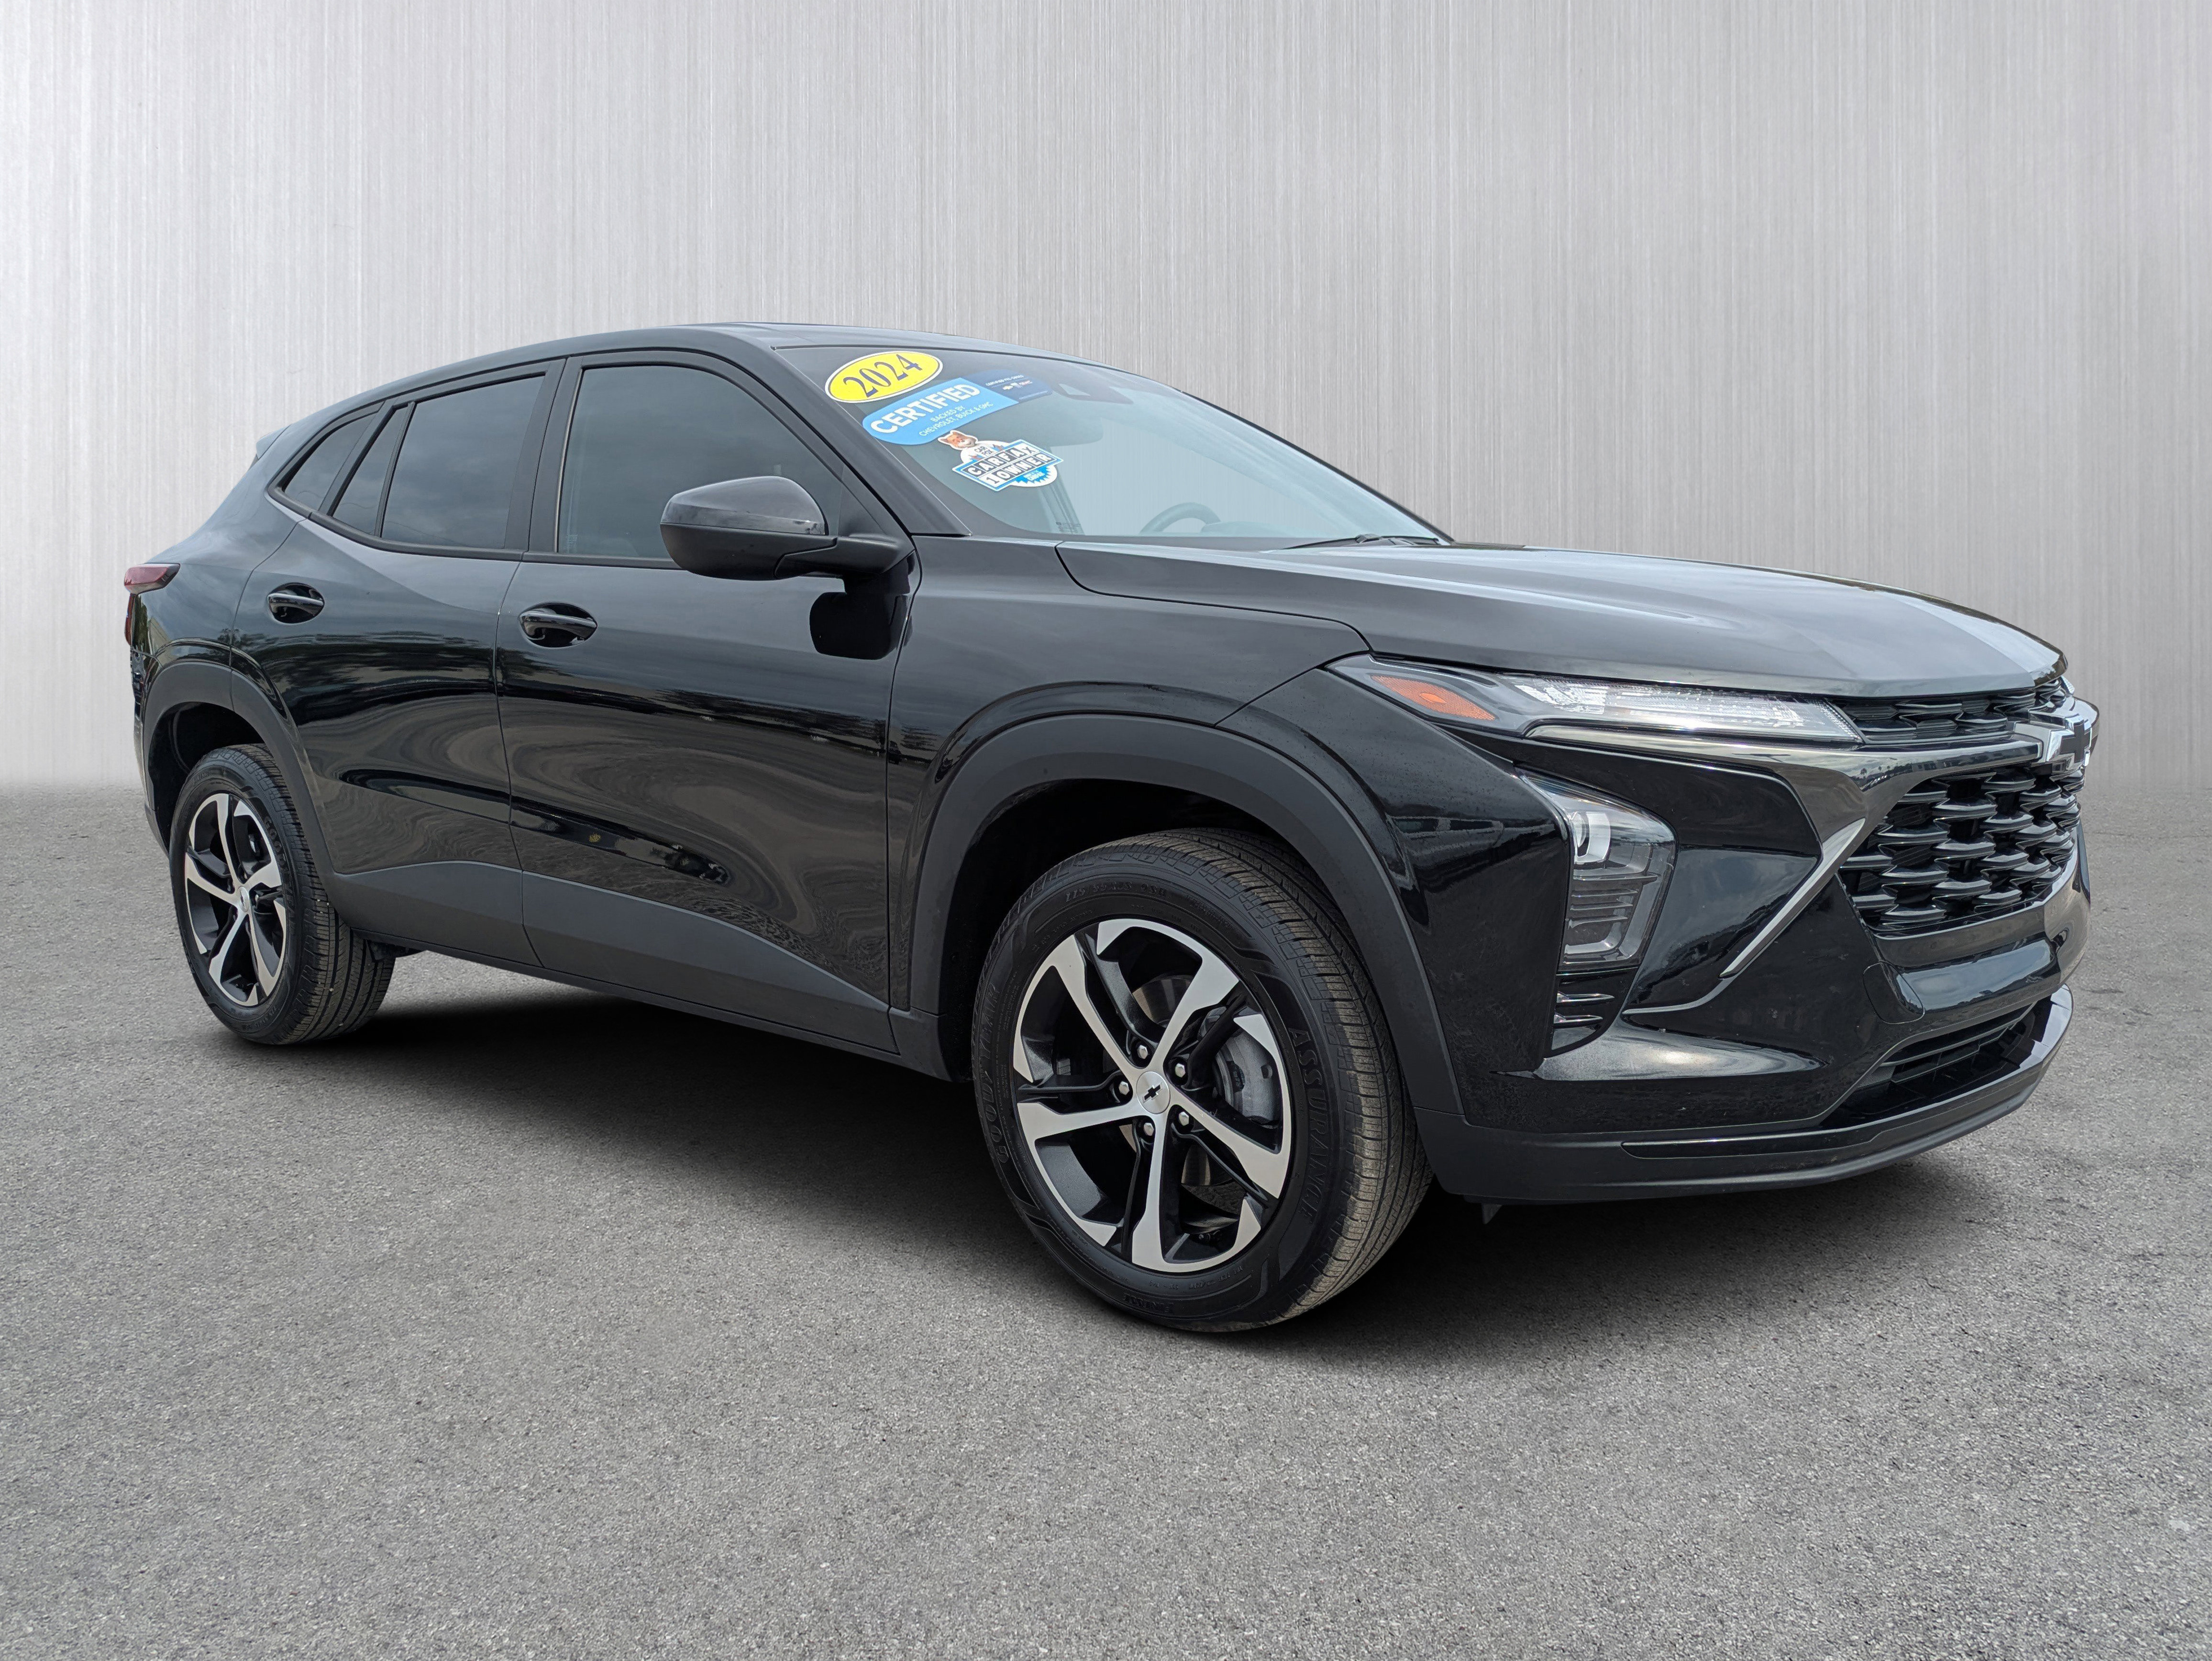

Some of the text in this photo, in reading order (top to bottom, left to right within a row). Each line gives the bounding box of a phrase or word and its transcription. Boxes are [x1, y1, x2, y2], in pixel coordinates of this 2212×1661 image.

[843, 354, 923, 398] 2024
[870, 384, 980, 433] CERTIFIED
[918, 417, 959, 436] CHEVROLET,
[955, 408, 974, 419] BUICK
[930, 409, 957, 422] BACKED
[968, 447, 1037, 475] CARFAX
[979, 983, 1009, 1163] GOODYEAR
[1289, 1028, 1329, 1224] ASSURANCE
